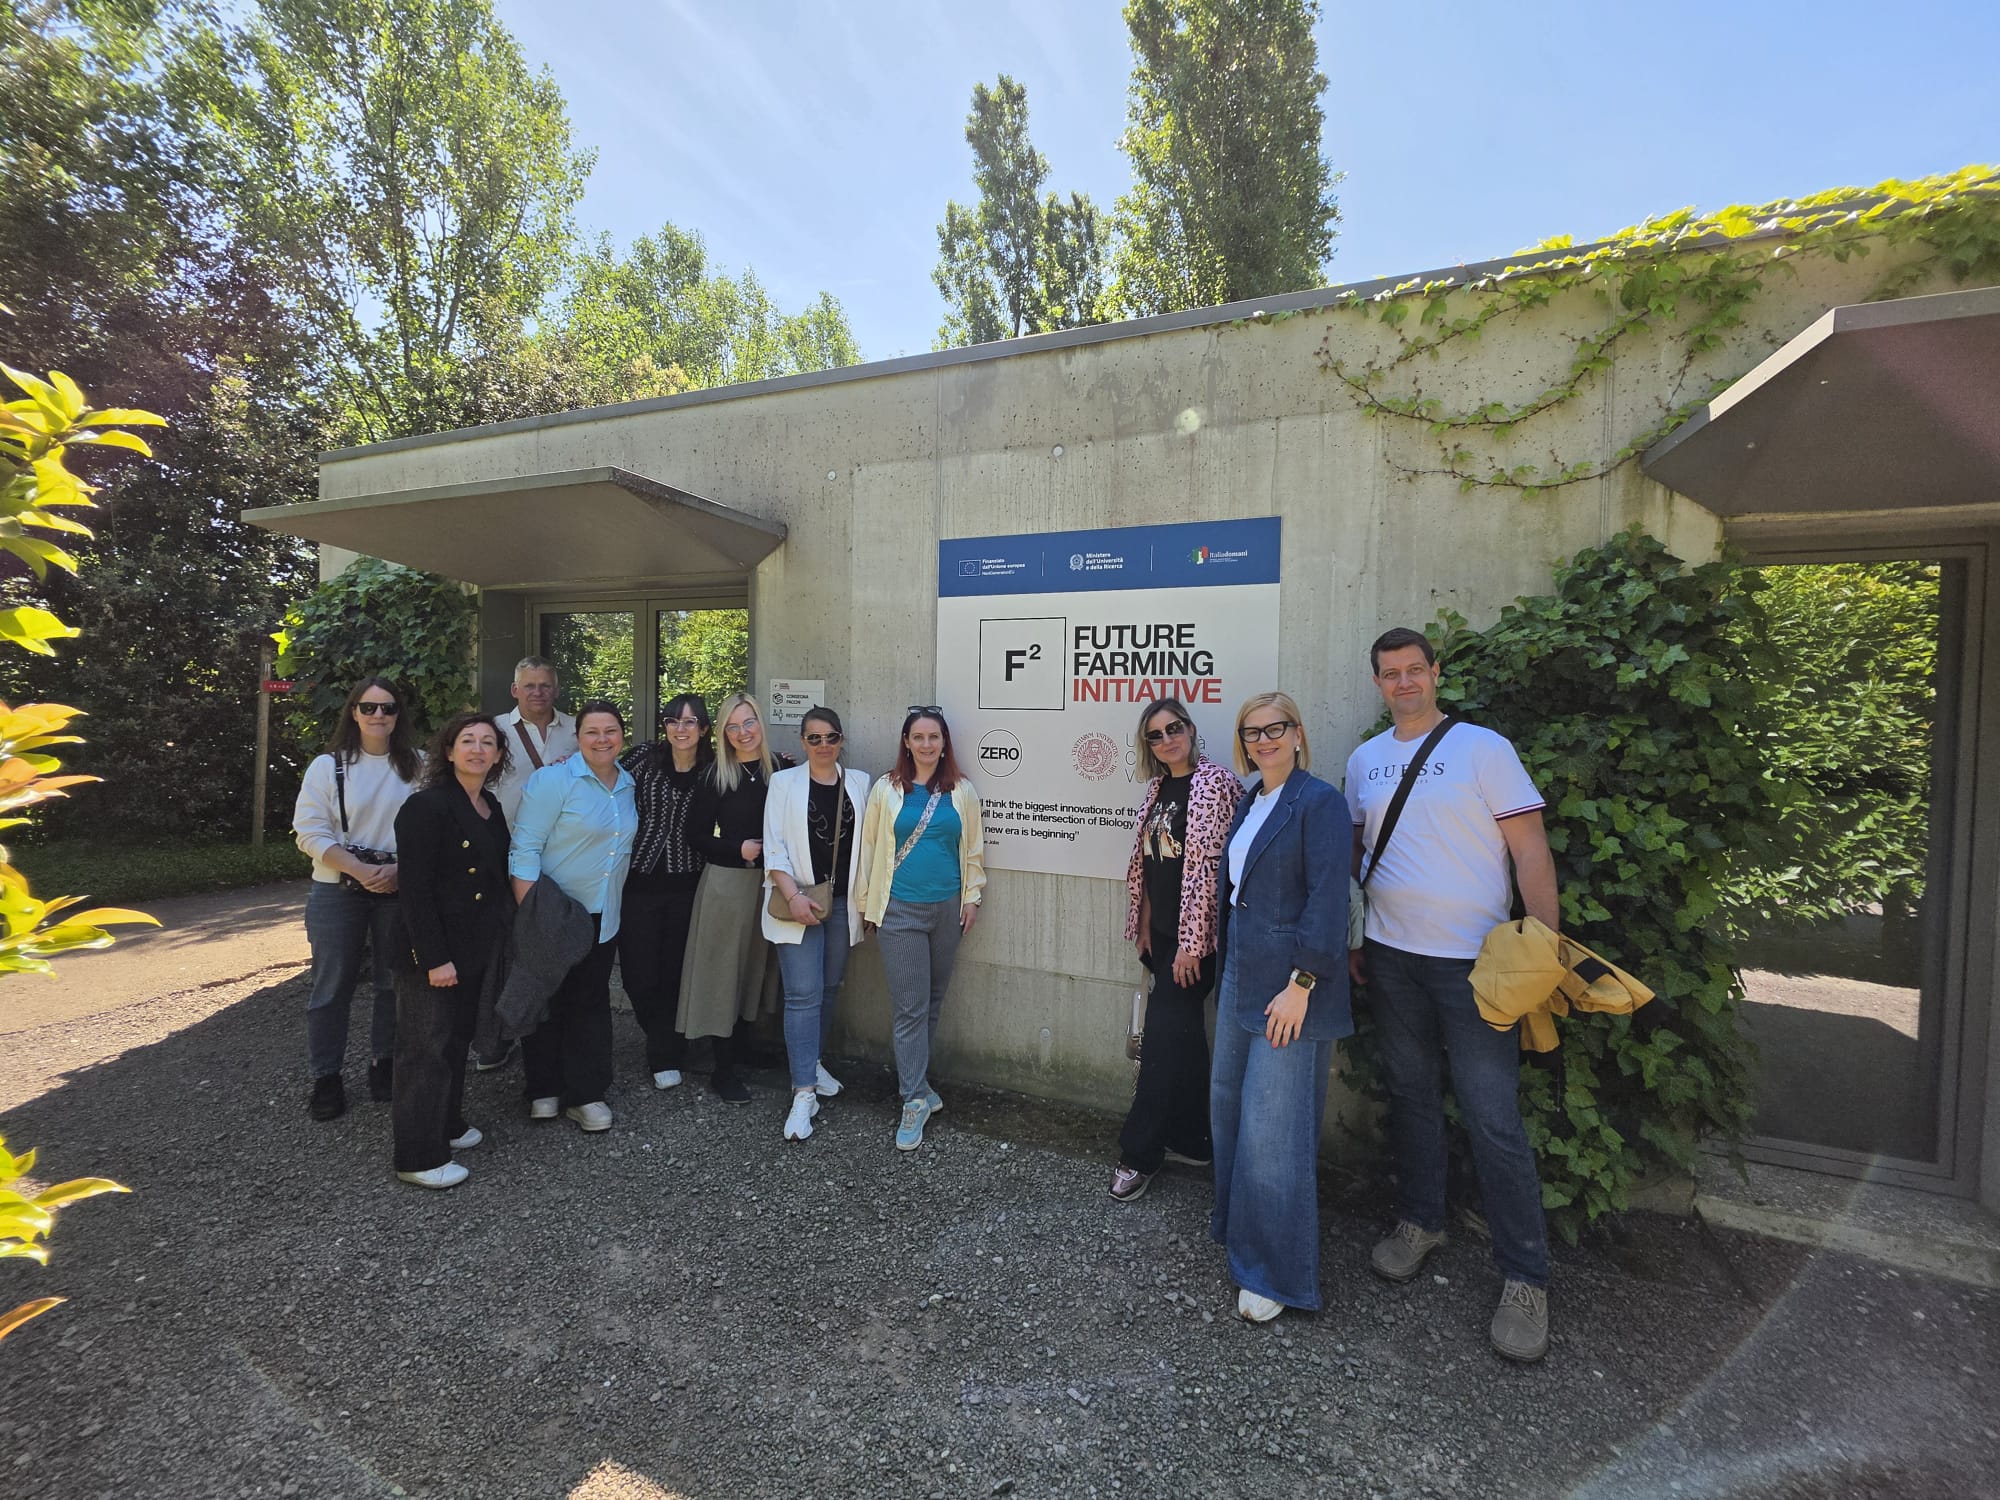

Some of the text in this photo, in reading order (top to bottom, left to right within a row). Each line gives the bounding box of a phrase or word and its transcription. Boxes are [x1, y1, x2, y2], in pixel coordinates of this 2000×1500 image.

[1210, 549, 1248, 558] Italiadomani
[1074, 624, 1196, 650] FUTURE
[1073, 651, 1214, 676] FARMING
[1073, 678, 1222, 704] INITIATIVE
[980, 747, 1020, 761] ZERO
[986, 799, 1006, 808] think
[1009, 800, 1023, 809] the
[1025, 801, 1058, 812] biggest
[1060, 803, 1112, 816] innovations
[1115, 807, 1125, 816] of
[993, 810, 1003, 819] be
[1005, 811, 1014, 820] at
[1016, 812, 1030, 821] the
[1032, 813, 1085, 825] intersection
[1088, 816, 1097, 825] of
[1099, 816, 1134, 830] Biology
[985, 826, 1003, 834] new
[1005, 827, 1019, 836] era
[1021, 827, 1029, 836] is
